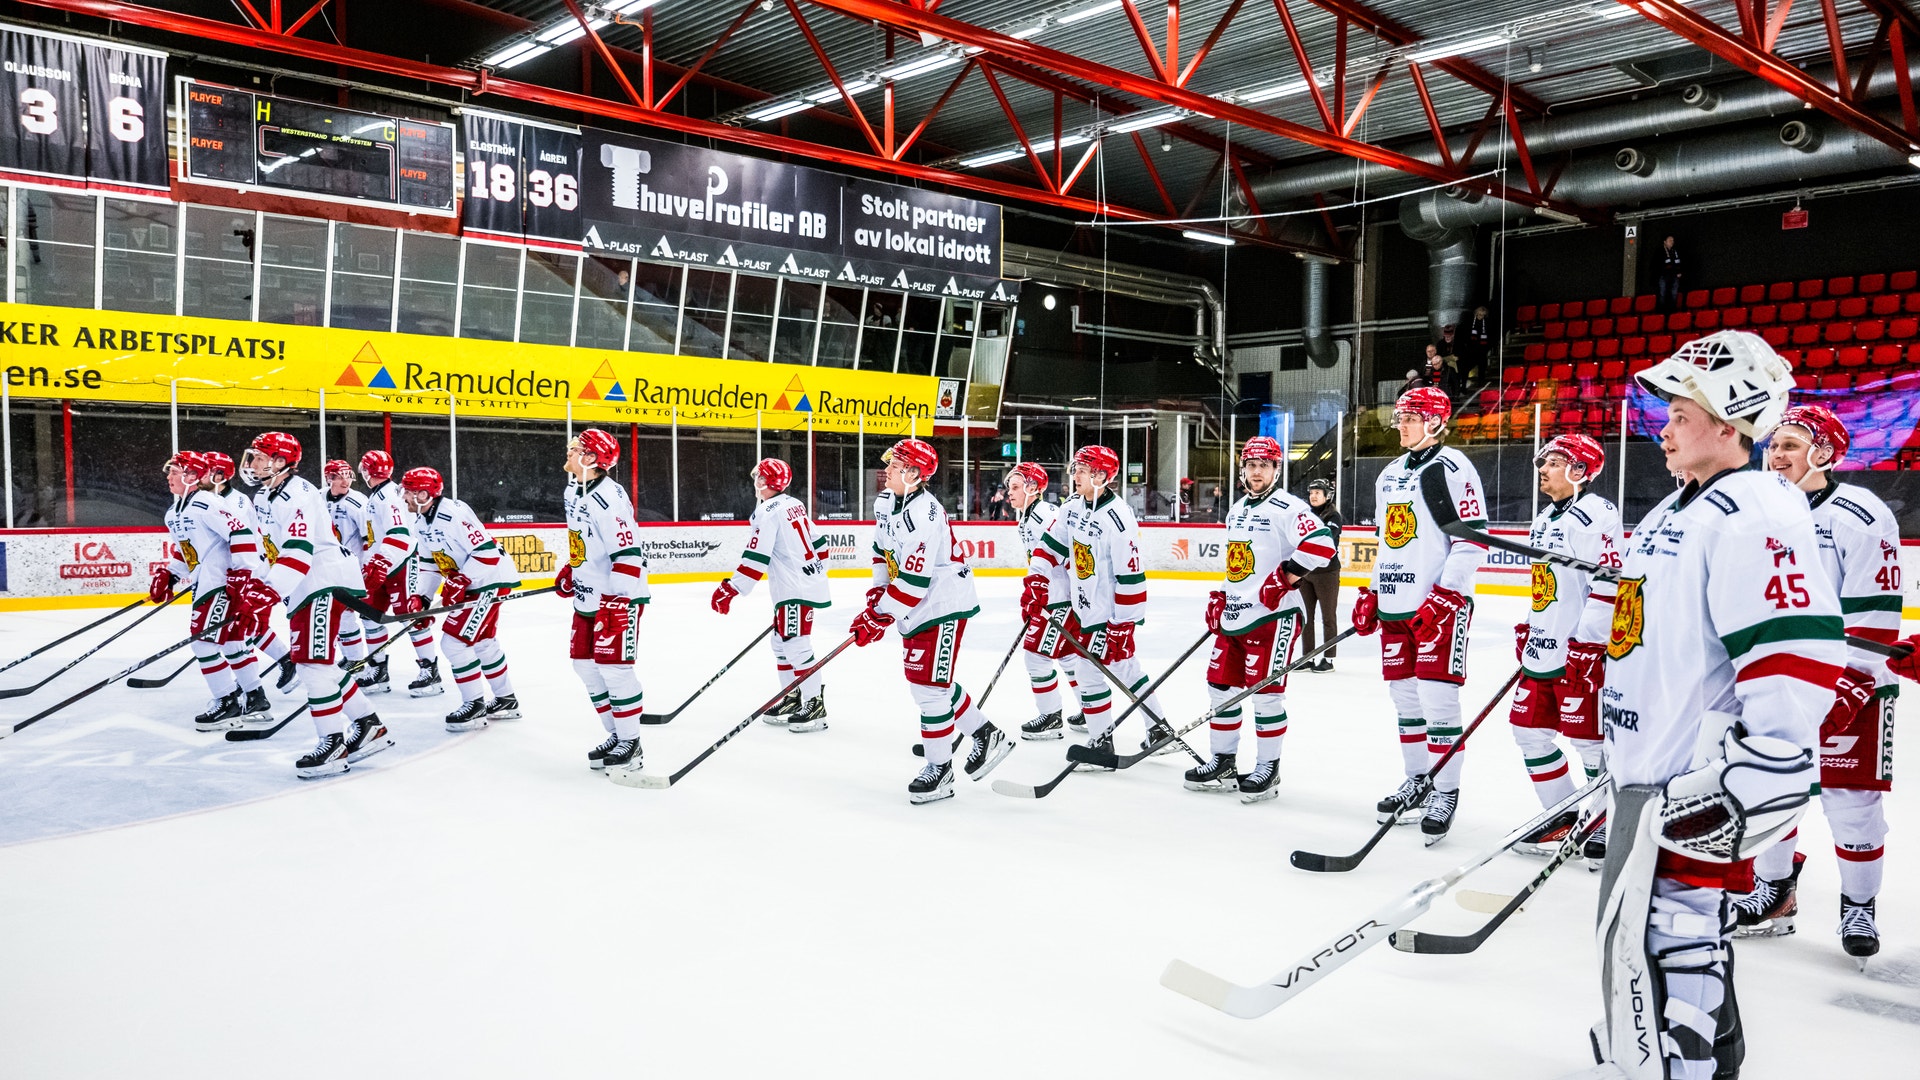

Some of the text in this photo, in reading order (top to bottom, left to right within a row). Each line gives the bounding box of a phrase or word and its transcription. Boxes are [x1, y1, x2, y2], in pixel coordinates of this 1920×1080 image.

[4, 60, 71, 82] OLAUSSON
[109, 72, 142, 89] BÖNA
[190, 91, 223, 105] PLAYER
[20, 87, 58, 135] 3
[109, 96, 144, 142] 6
[256, 101, 271, 122] H
[281, 127, 372, 147] WESTERSTRAND SPORTSYSTEM
[383, 126, 396, 142] G
[400, 126, 427, 139] PLAYER
[191, 137, 224, 151] PLAYER
[469, 139, 516, 157] ELGSTRÖM
[539, 151, 568, 165] ÅGREN
[400, 168, 427, 181] PLAYER
[470, 160, 516, 203] 18
[528, 169, 579, 212] 36
[861, 193, 987, 235] Stolt partner
[799, 210, 827, 239] AB
[1627, 227, 1635, 237] A
[854, 227, 992, 265] av lokal idrott
[73, 326, 286, 361] ARBETSPLATS!
[6, 363, 102, 390] en.se
[405, 362, 571, 399] Ramudden
[383, 395, 423, 405] WORK
[633, 378, 768, 410] Ramudden
[615, 407, 648, 416] WORK
[818, 390, 929, 419] Ramudden
[1459, 500, 1481, 518] 23
[393, 515, 403, 526] 11
[1297, 519, 1317, 537] 32
[288, 522, 307, 538] 42
[468, 530, 485, 546] 29
[616, 530, 633, 547] 39
[74, 542, 116, 562] ICA
[669, 551, 700, 559] Persson
[1198, 543, 1220, 558] VS
[905, 554, 926, 573] 66
[1127, 556, 1140, 572] 41
[1599, 551, 1623, 569] 26
[63, 564, 129, 576] KVANTUM
[1874, 565, 1901, 591] 40
[82, 581, 111, 589] NYBRO
[1764, 573, 1811, 609] 45
[1427, 592, 1459, 612] CCM
[314, 592, 331, 658] RADONE
[1269, 919, 1390, 989] VAPOR
[1630, 970, 1651, 1067] VAPOR
